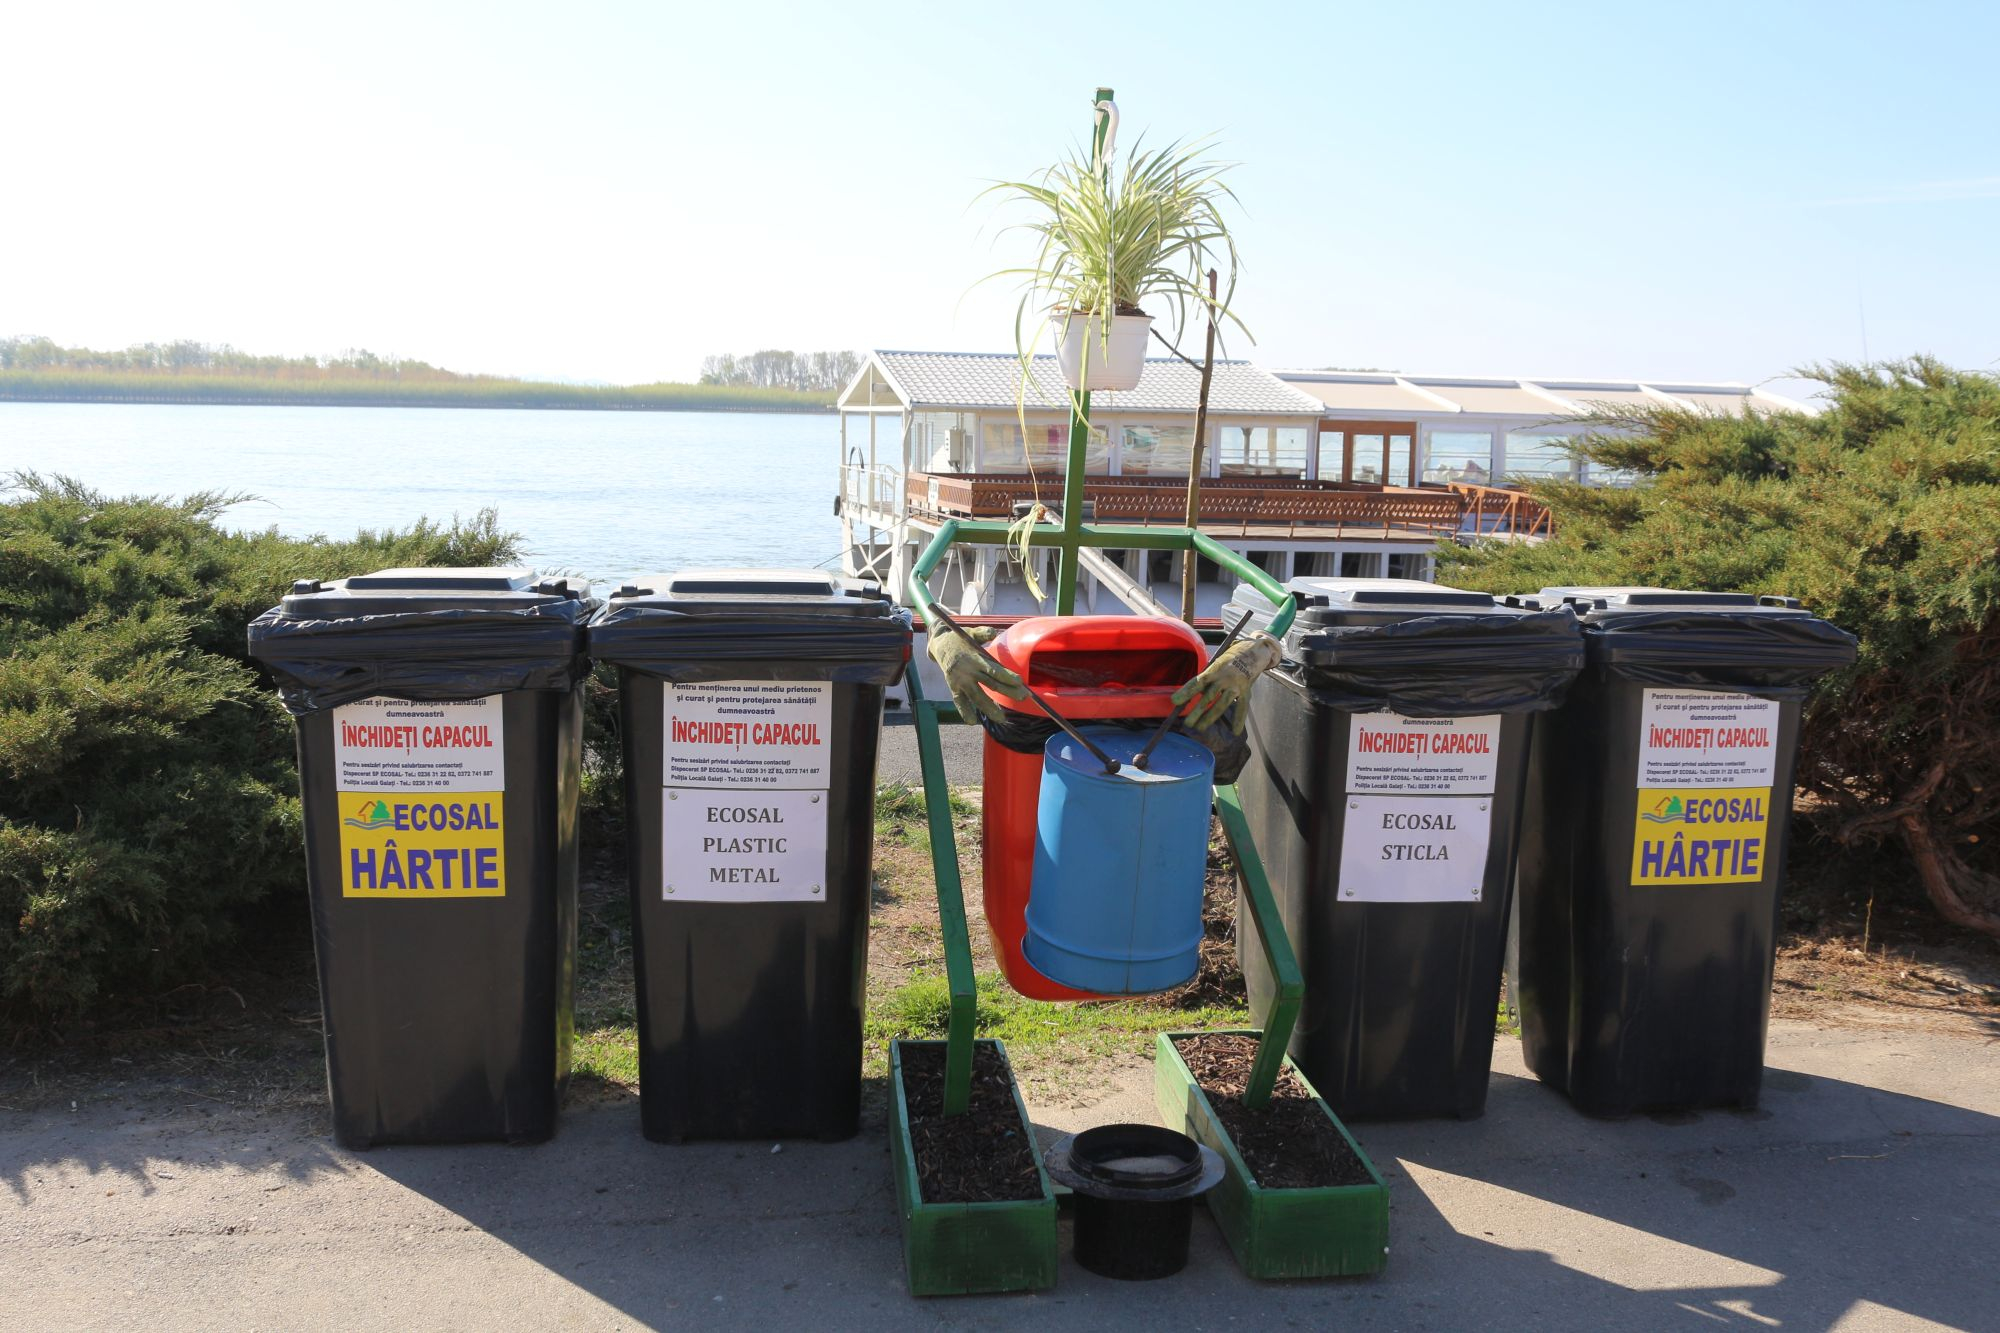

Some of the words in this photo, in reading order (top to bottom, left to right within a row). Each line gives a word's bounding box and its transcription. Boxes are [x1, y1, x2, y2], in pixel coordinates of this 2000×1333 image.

[672, 682, 697, 690] Pentru
[698, 683, 741, 692] menținerea
[787, 686, 822, 694] prietenos
[715, 696, 740, 704] pentru
[742, 697, 781, 705] protejarea
[717, 707, 775, 715] dumneavoastră
[342, 720, 418, 756] ÎNCHIDEȚI
[422, 725, 493, 748] CAPACUL
[672, 716, 748, 752] ÎNCHIDEȚI
[752, 722, 821, 746] CAPACUL
[1358, 727, 1429, 760] ÎNCHIDEȚI
[1432, 733, 1490, 754] CAPACUL
[1649, 723, 1714, 755] ÎNCHIDEȚI
[1717, 727, 1769, 748] CAPACUL
[394, 803, 499, 831] ECOSAL
[707, 807, 784, 823] ECOSAL
[1382, 813, 1457, 830] ECOSAL
[1684, 797, 1765, 824] ECOSAL
[703, 837, 788, 853] PLASTIC
[1381, 844, 1449, 860] STICLA
[1640, 831, 1761, 878] HÂRTIE
[350, 839, 499, 889] HÂRTIE
[709, 867, 780, 883] METAL
